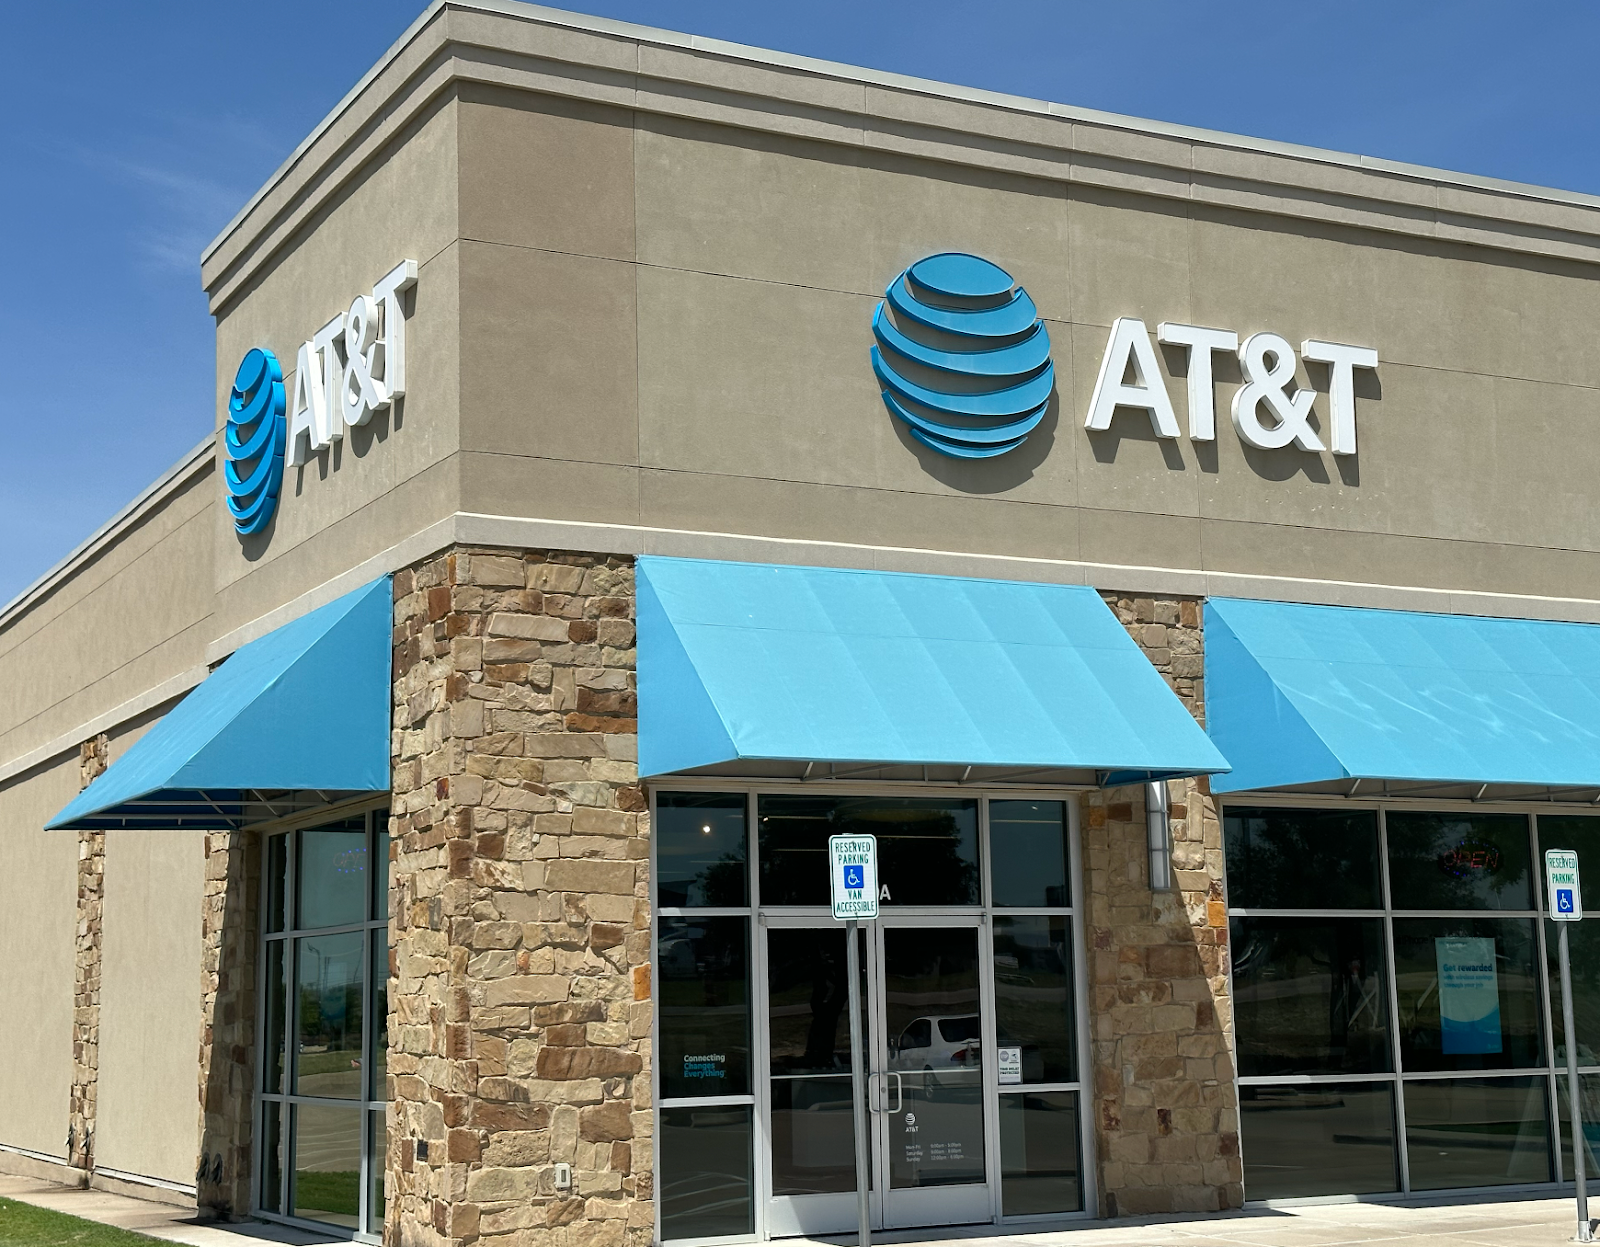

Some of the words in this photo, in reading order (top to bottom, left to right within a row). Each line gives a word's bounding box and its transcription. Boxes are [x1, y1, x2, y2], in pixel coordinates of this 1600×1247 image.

[287, 258, 418, 468] AT&T
[1084, 316, 1379, 455] AT&T
[835, 842, 871, 853] RESERVED
[838, 853, 869, 864] PARKING
[1443, 850, 1499, 869] OPEN
[1549, 857, 1576, 869] RESERVED
[1551, 873, 1575, 884] PARKING
[847, 889, 863, 900] VAN
[836, 900, 875, 913] ACCESSIBLE
[1443, 963, 1456, 972] Get
[1458, 963, 1493, 972] rewarded
[683, 1054, 726, 1063] Connecting
[683, 1062, 715, 1070] Changes
